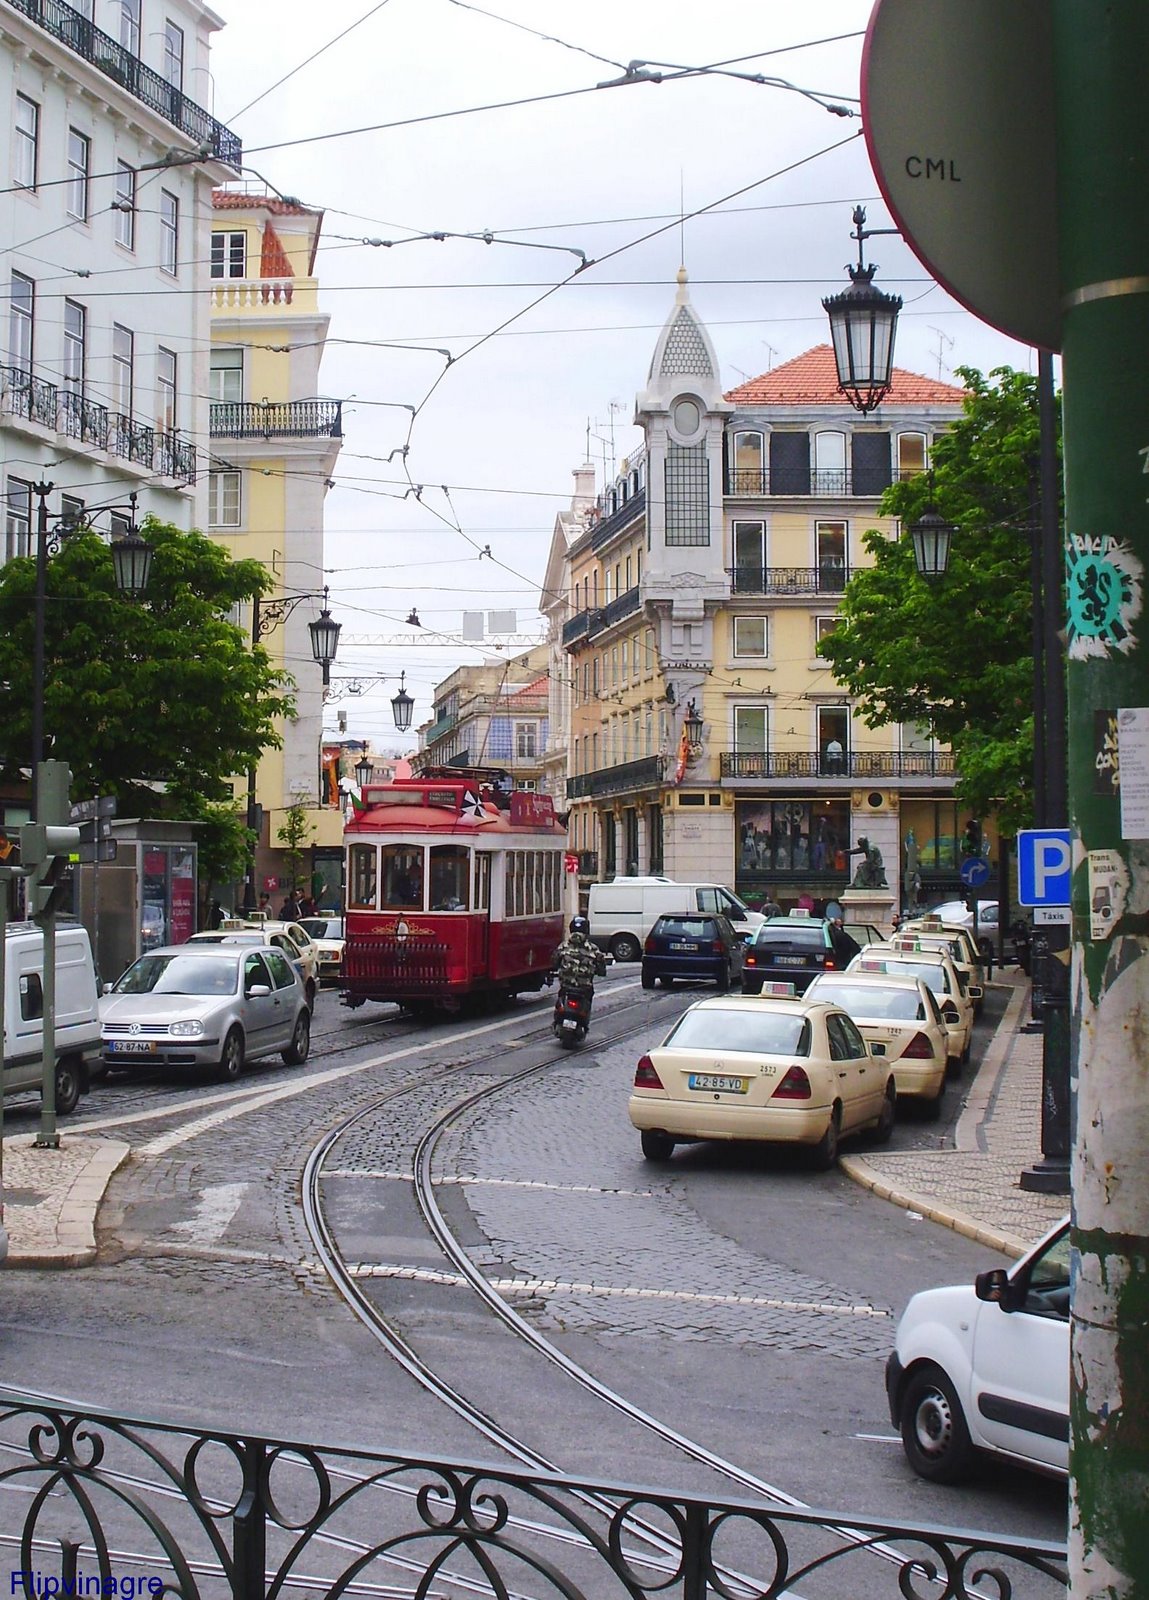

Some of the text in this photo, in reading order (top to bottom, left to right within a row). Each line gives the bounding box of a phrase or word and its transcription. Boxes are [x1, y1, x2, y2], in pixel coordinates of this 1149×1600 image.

[905, 156, 961, 182] CML
[1034, 837, 1070, 898] P
[1042, 911, 1064, 920] Táxis
[760, 1065, 777, 1074] 2573
